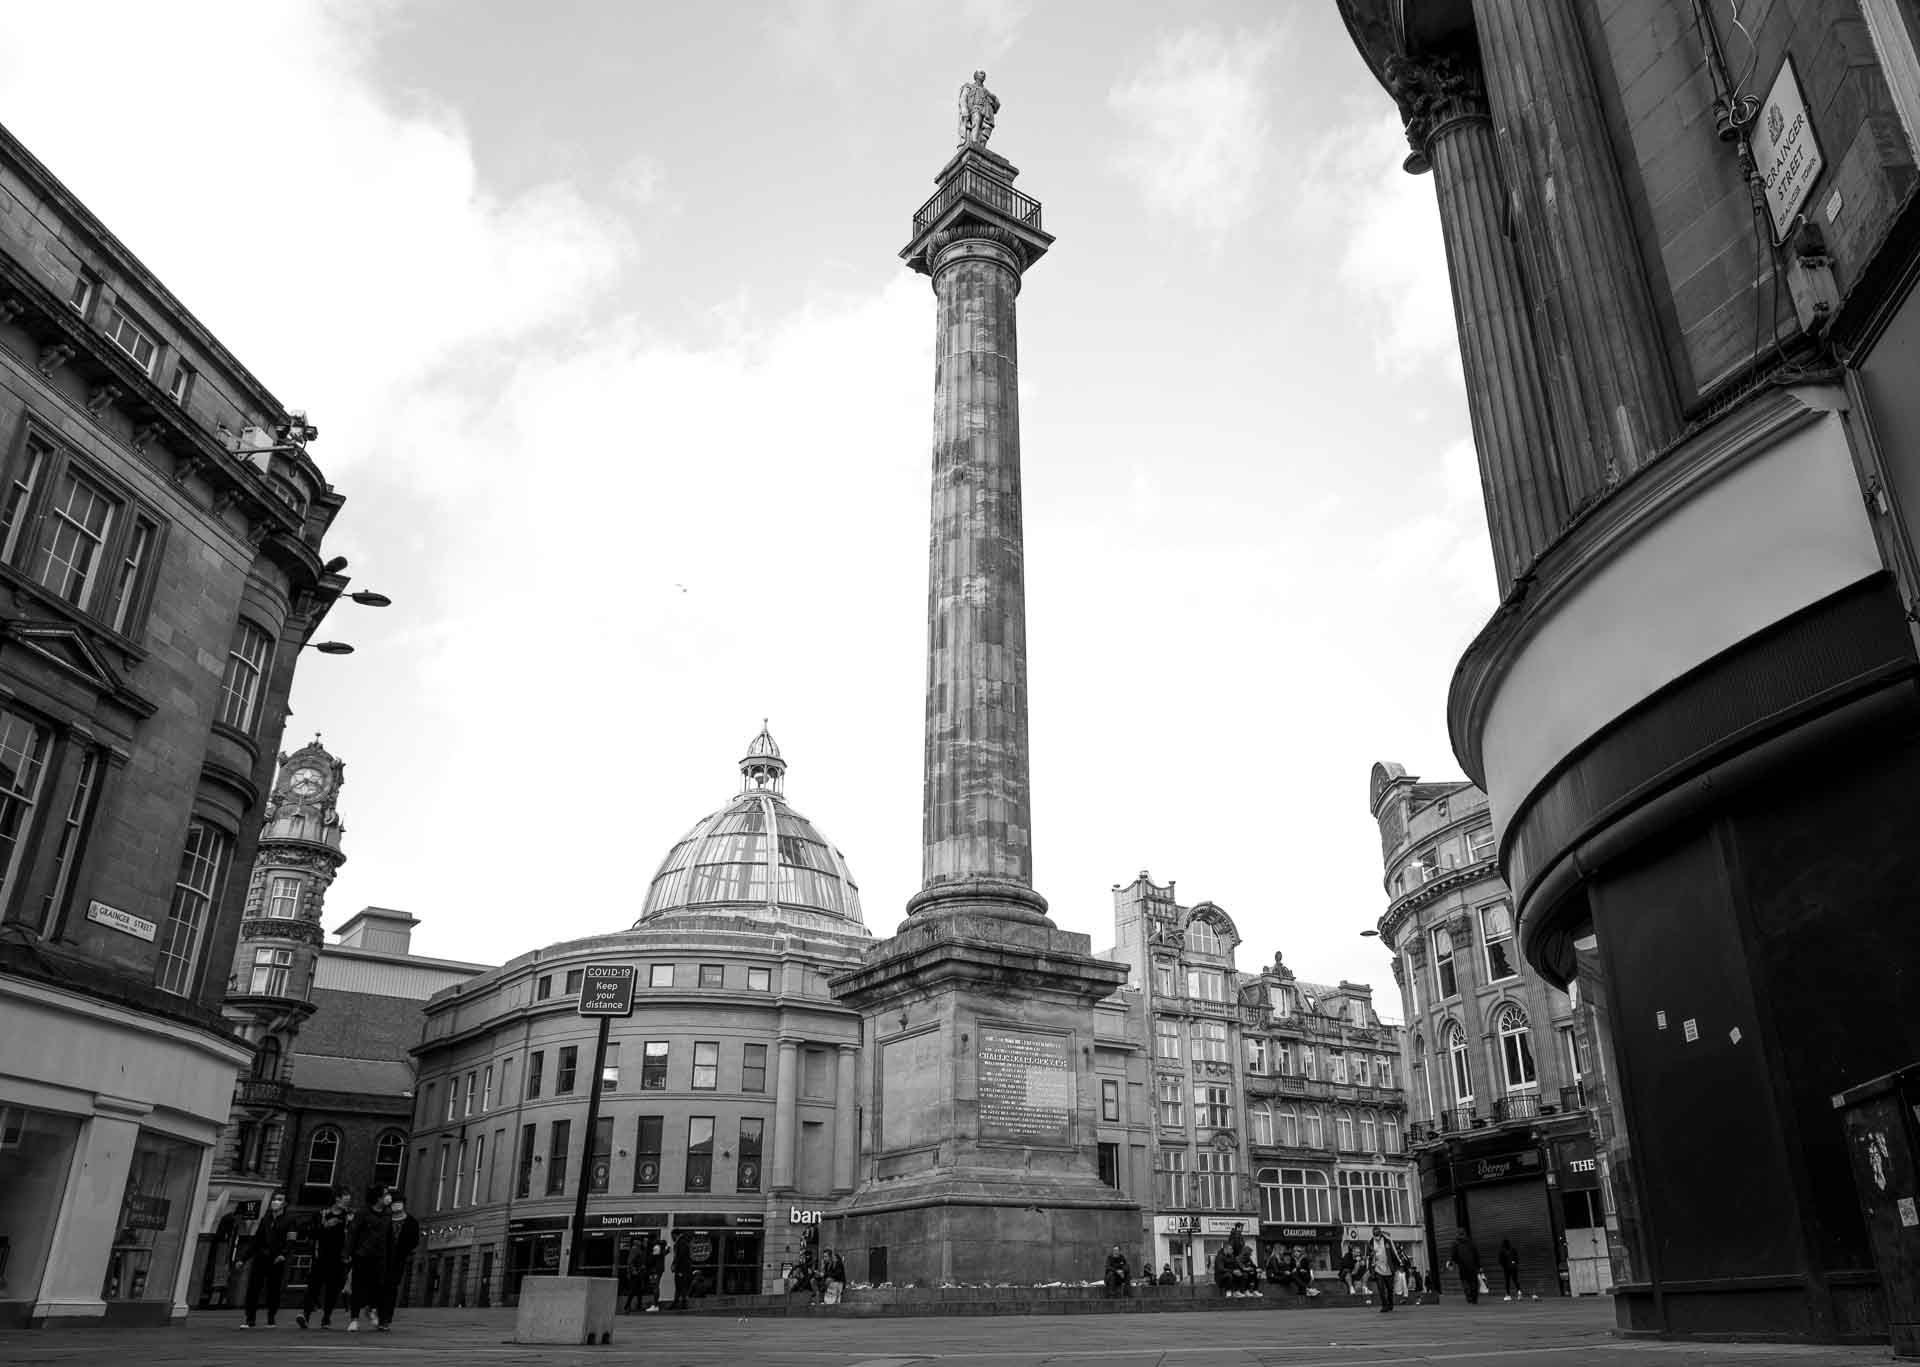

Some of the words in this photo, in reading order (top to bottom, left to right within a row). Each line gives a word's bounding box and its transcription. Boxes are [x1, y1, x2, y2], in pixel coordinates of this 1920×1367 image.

[1766, 113, 1805, 190] GRAINGER
[1778, 145, 1805, 201] STREET
[99, 907, 130, 924] GRAINGER
[134, 919, 153, 932] STREET
[588, 968, 631, 976] COVID-19
[596, 981, 618, 991] Keep
[596, 992, 616, 1001] your
[585, 1000, 623, 1009] distance
[1570, 1159, 1596, 1173] THE
[602, 1216, 633, 1225] banyan
[790, 1206, 825, 1224] ban
